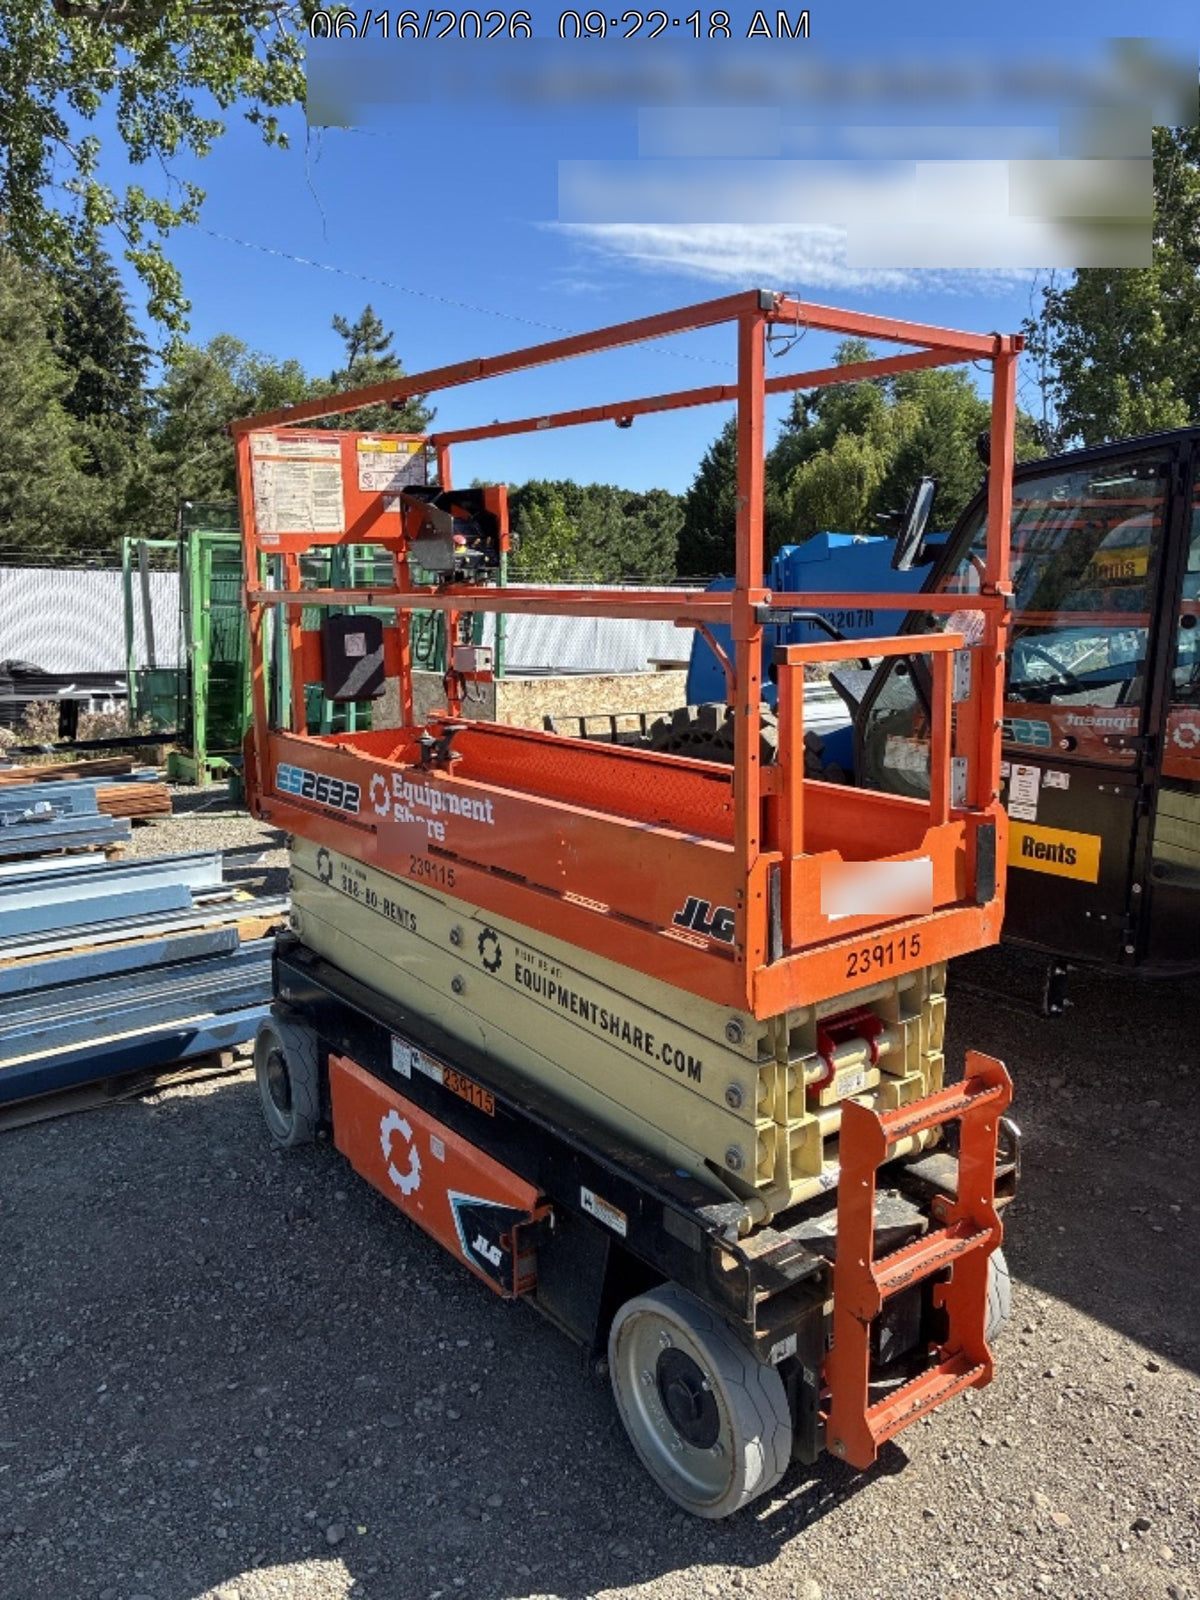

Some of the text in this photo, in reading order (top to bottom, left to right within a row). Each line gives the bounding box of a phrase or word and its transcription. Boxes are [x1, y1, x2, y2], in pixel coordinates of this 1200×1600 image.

[275, 762, 361, 815] ES2632
[391, 773, 496, 826] Equipment
[410, 854, 456, 888] 239115
[1021, 834, 1077, 866] Rents
[672, 895, 736, 946] JLG
[845, 932, 921, 979] 239115
[514, 962, 704, 1084] EQUIPMENTSHARE.COM
[444, 1067, 494, 1115] 239115
